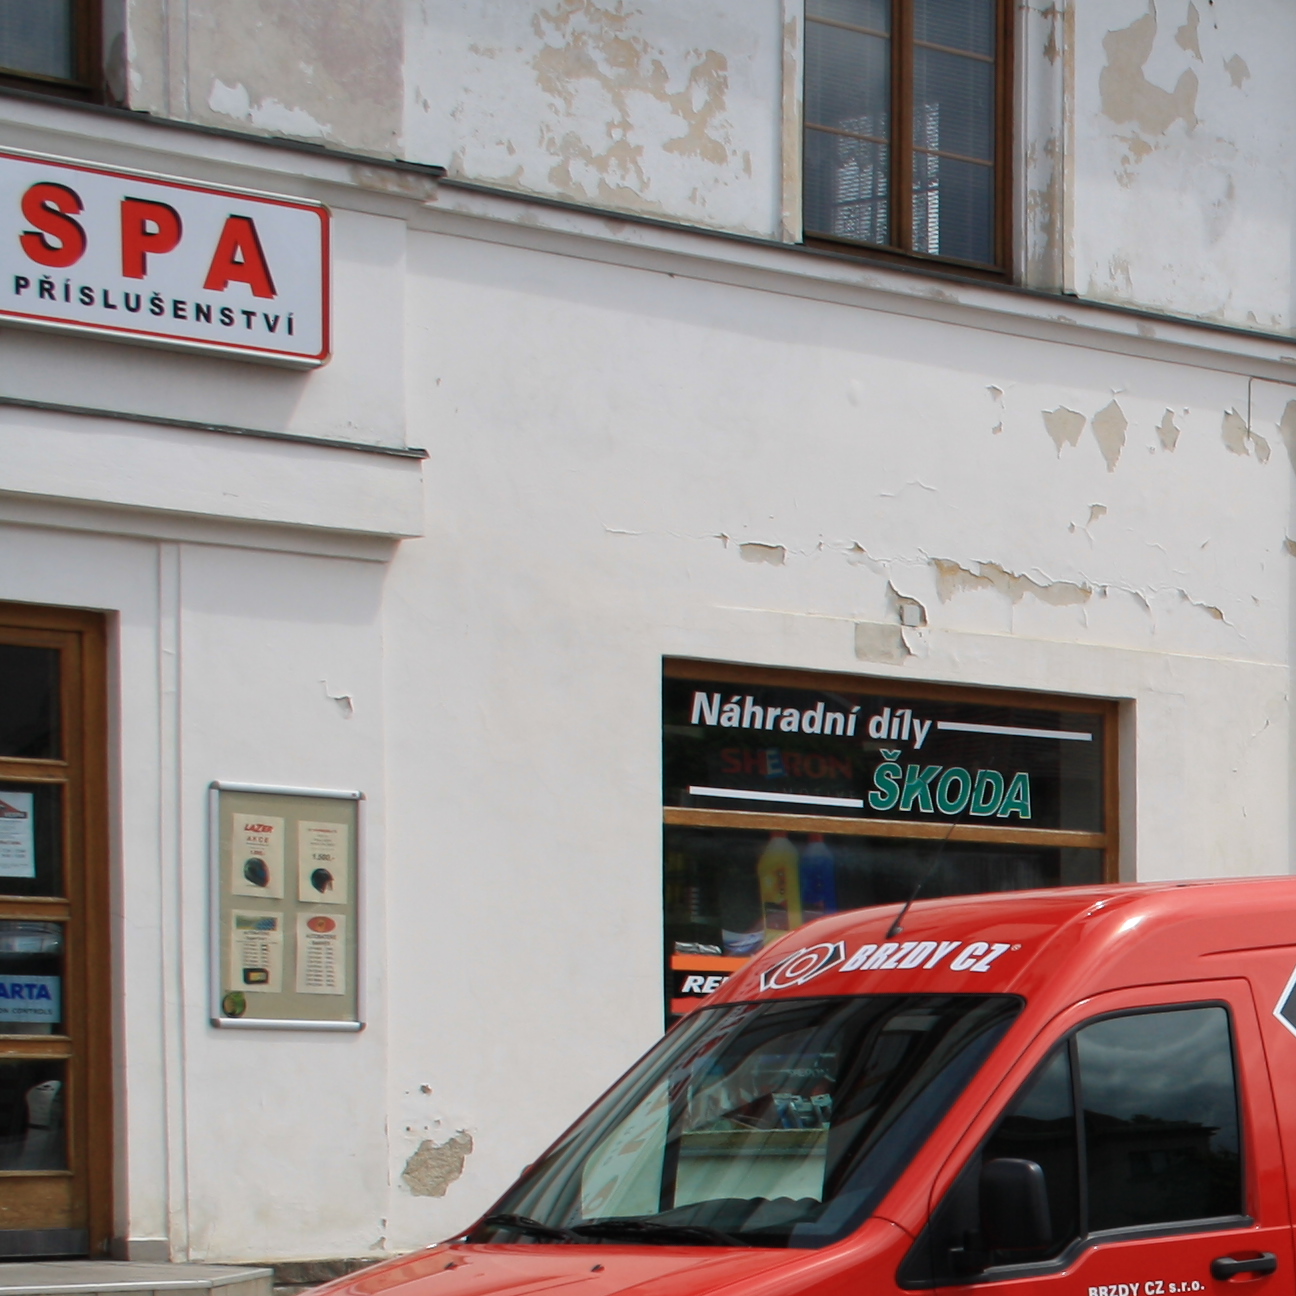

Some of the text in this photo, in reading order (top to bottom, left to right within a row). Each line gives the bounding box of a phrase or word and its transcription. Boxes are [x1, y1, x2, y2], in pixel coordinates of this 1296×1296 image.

[14, 275, 296, 336] PŘÍSLUŠENSTVÍ
[690, 691, 932, 750] Náhradní díly
[720, 747, 854, 779] SHERON
[868, 749, 1031, 820] ŠKODA
[838, 941, 1011, 972] BRZDY CZ
[1145, 1280, 1165, 1295] CZ
[1169, 1280, 1205, 1294] s.r.o.
